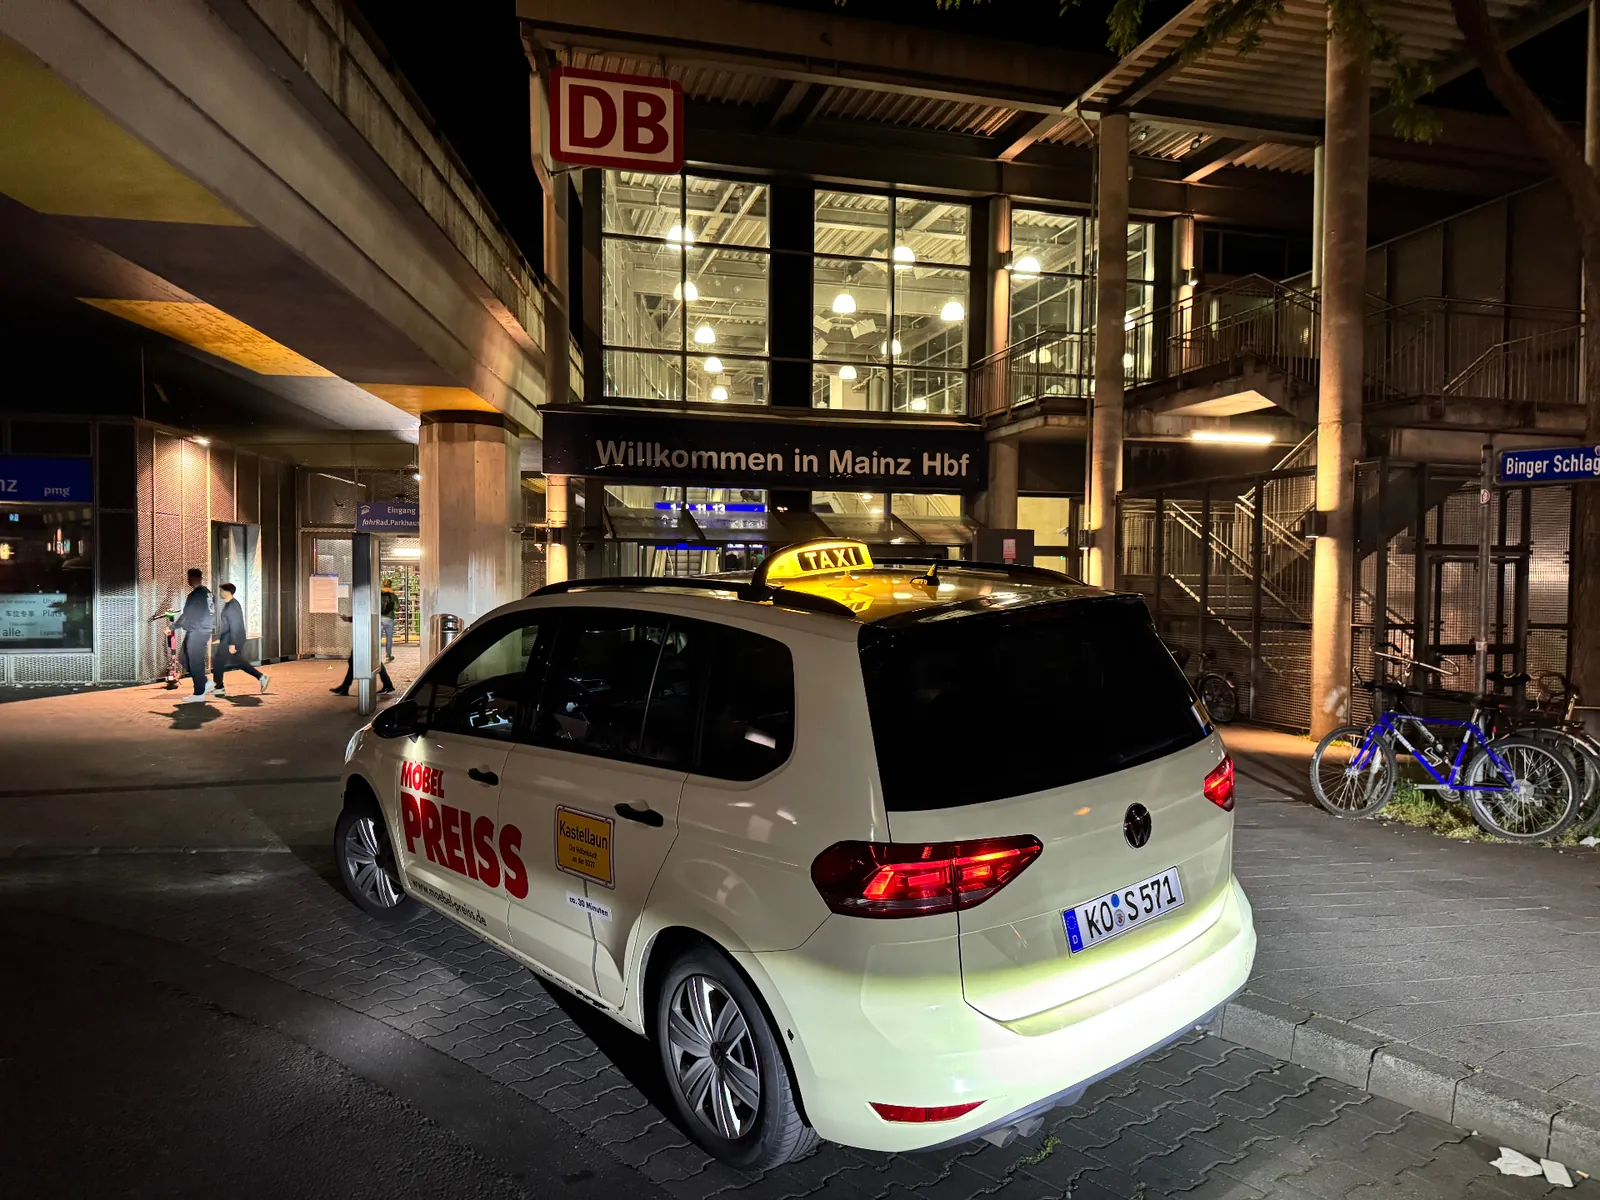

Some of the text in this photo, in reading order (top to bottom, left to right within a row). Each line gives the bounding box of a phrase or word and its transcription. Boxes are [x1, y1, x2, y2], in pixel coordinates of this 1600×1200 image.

[568, 83, 669, 154] DB
[595, 439, 970, 477] Willkommen in Mainz Hbf
[1506, 456, 1549, 478] Binger
[44, 486, 70, 498] pmg
[387, 506, 416, 515] Eingang
[804, 547, 858, 570] TAXI
[400, 760, 445, 799] MÖBEL
[400, 791, 529, 899] PREISS
[560, 820, 608, 849] Kastellaun
[412, 880, 487, 926] www.moebel-preiss.de
[586, 901, 609, 917] Minuten
[1084, 901, 1114, 938] KO
[1139, 875, 1177, 914] 571
[1072, 934, 1079, 945] D
